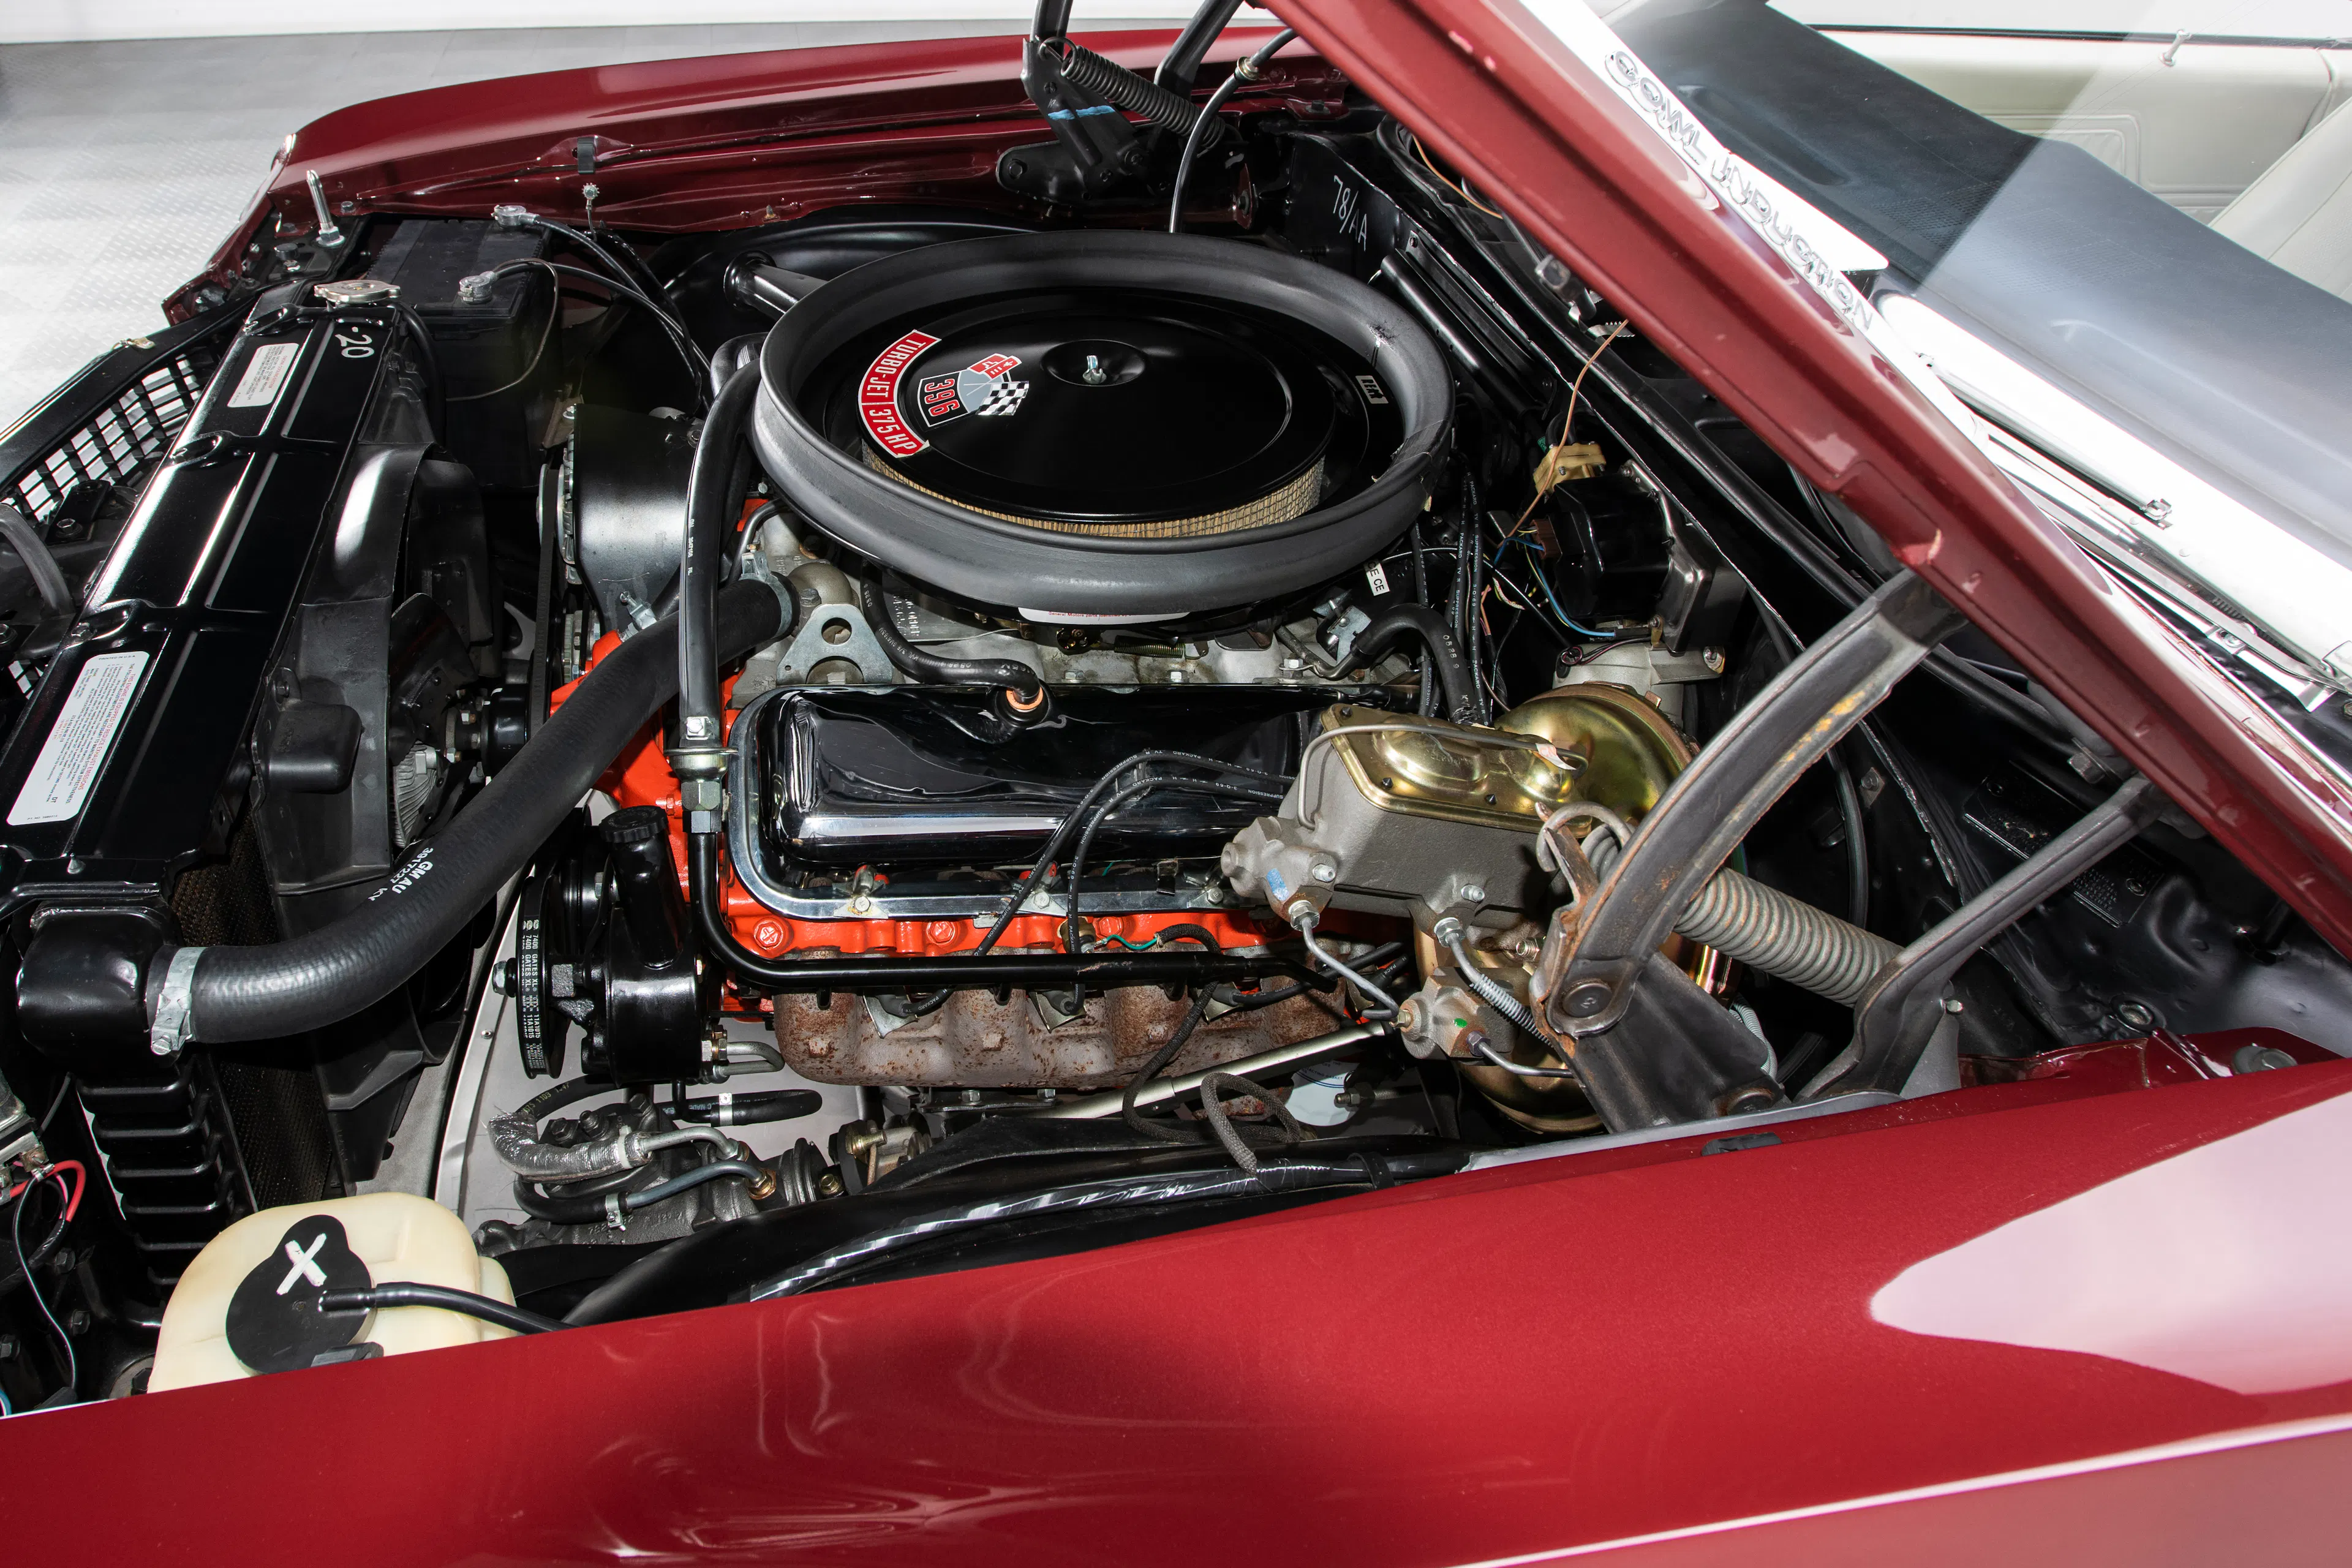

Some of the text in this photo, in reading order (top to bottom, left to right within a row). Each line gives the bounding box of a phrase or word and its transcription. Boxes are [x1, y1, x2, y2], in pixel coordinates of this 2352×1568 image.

[1605, 51, 1873, 331] COWL INDUCTION
[866, 339, 927, 451] TURBO-JET 375 HP
[924, 378, 960, 418] 396
[1367, 561, 1385, 592] CE CE
[120, 682, 132, 697] ENGINE
[127, 673, 136, 682] THIS
[108, 702, 123, 722] EQUIPPED
[97, 728, 111, 746] REDUCE
[88, 746, 103, 766] EXHAUST
[1172, 750, 1201, 759] PACKARD
[77, 766, 94, 790] EMISSIONS
[1101, 754, 1138, 781] SUPPRESSION
[1132, 776, 1163, 786] PACKARD
[1248, 789, 1284, 799] SUPPRESSION
[1080, 807, 1105, 845] SUPPRESSION
[390, 847, 434, 884] 3917227
[392, 861, 434, 894] GM AU
[1028, 853, 1046, 880] PACKARD
[987, 906, 1011, 940] SUPPRESSION
[1383, 964, 1396, 976] PACK
[918, 995, 940, 1011] PACKARD
[527, 1014, 535, 1038] 11A1015
